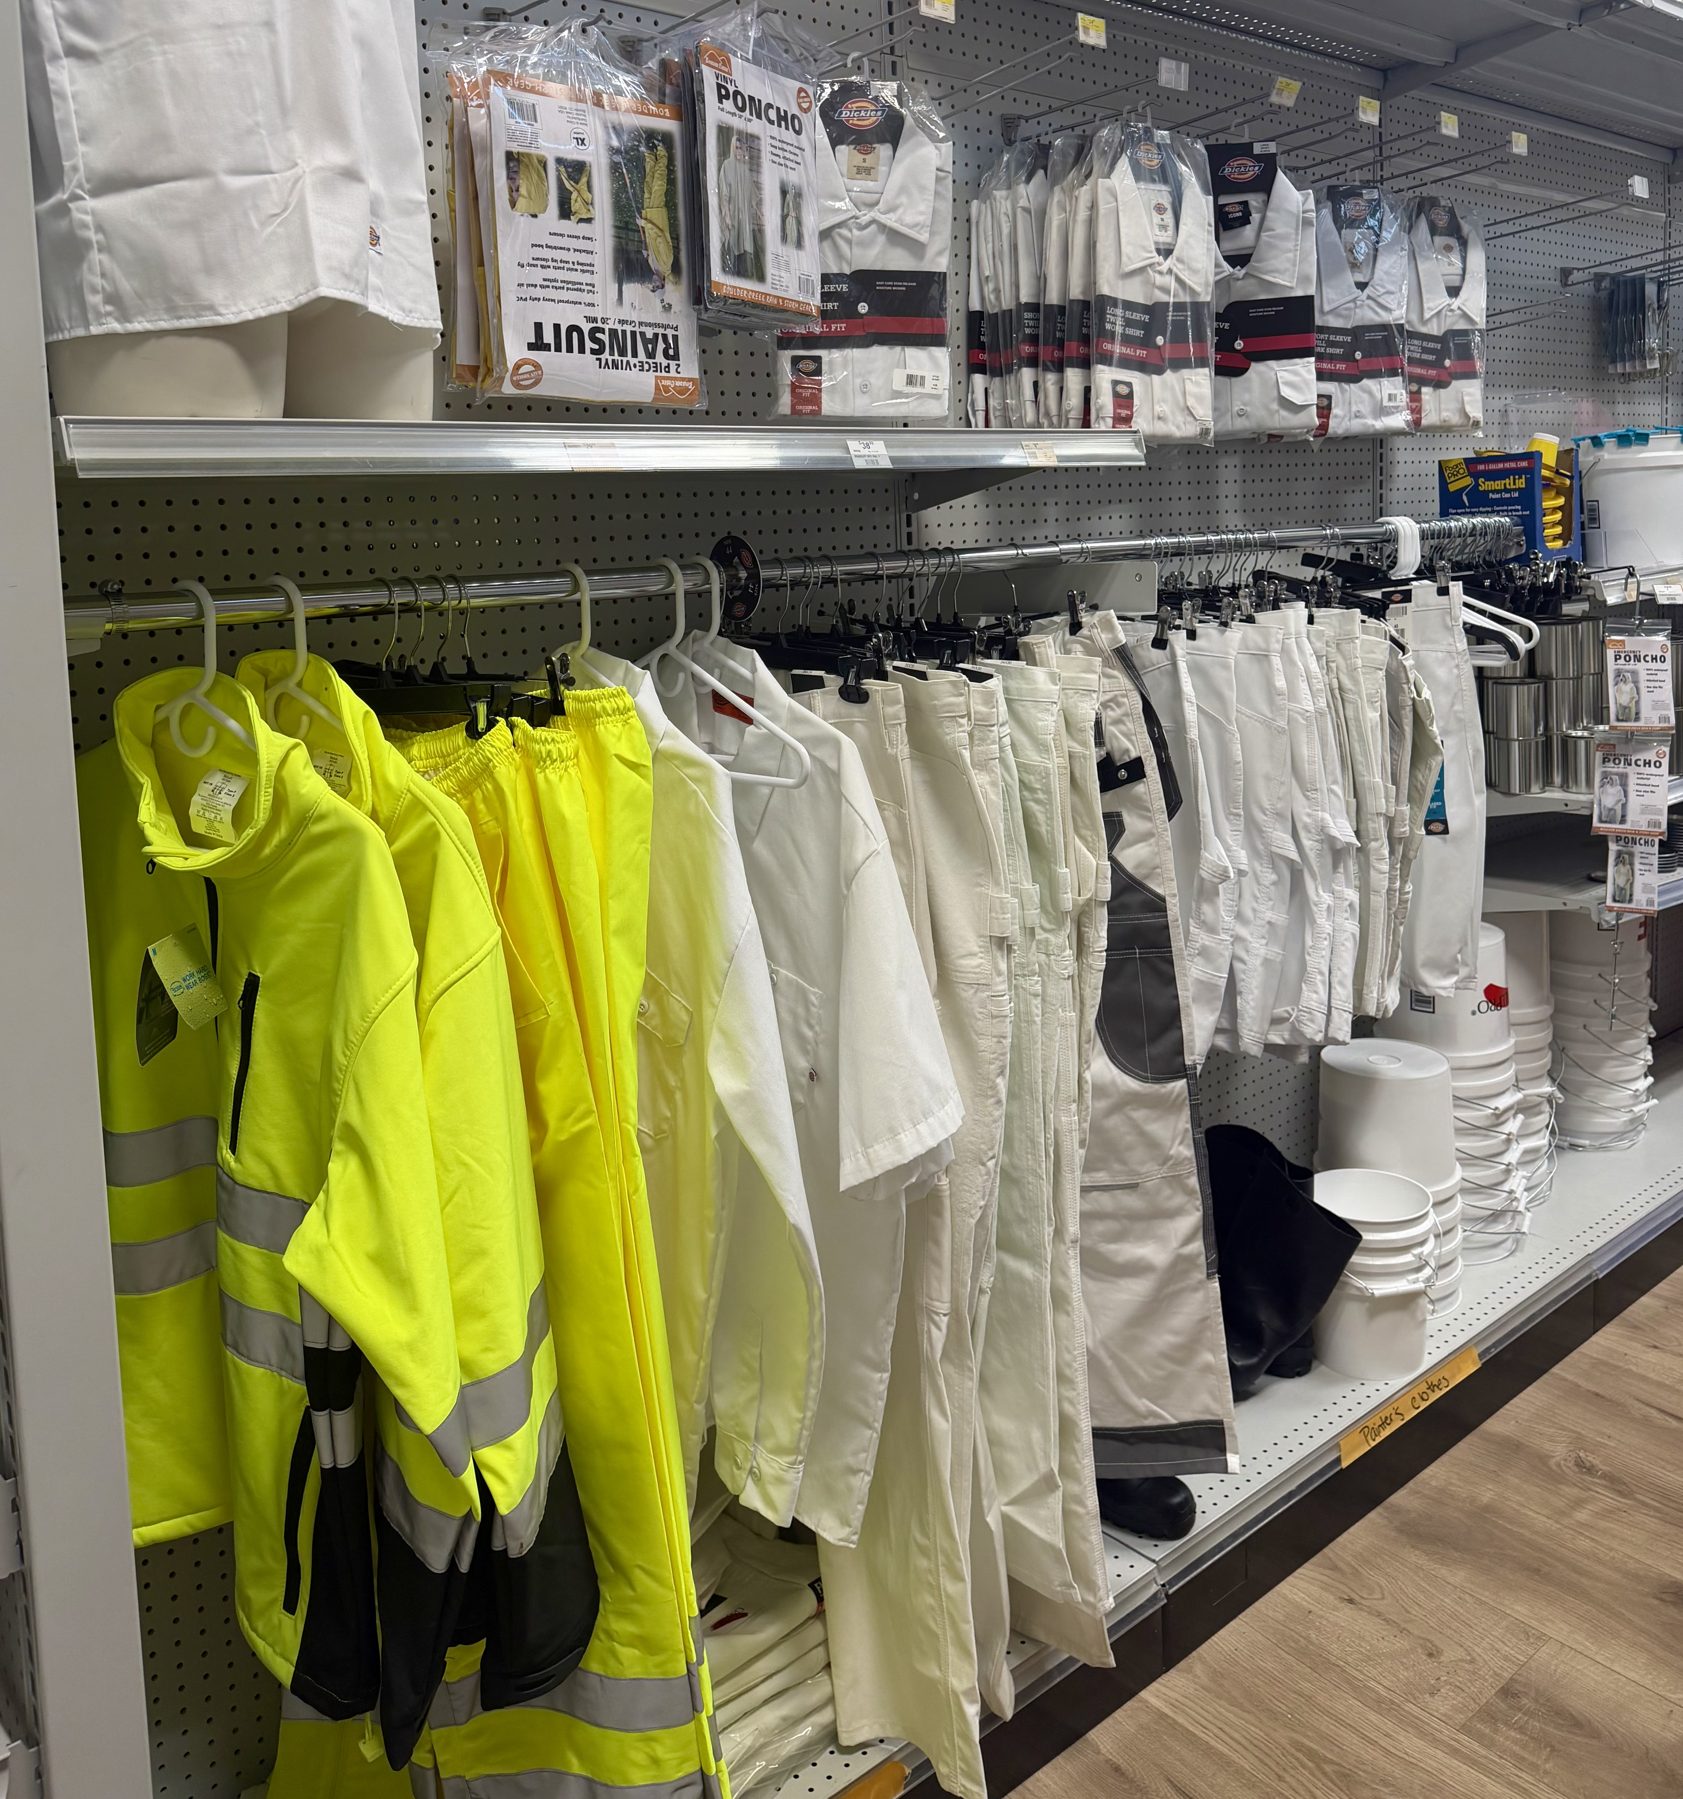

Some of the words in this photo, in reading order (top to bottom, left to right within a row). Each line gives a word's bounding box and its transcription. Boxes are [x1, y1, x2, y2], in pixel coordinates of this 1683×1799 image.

[714, 71, 738, 88] VINYL
[716, 81, 803, 136] PONCHO
[840, 109, 882, 118] Dickies
[573, 137, 587, 147] XL
[1224, 166, 1260, 174] Dickies
[1106, 306, 1124, 317] LONG
[1125, 310, 1150, 322] SLEEVE
[584, 316, 598, 324] MIL
[618, 318, 636, 328] Grade
[638, 321, 679, 332] Professional
[831, 324, 846, 332] FIT
[1125, 328, 1144, 338] SHIRT
[1330, 334, 1352, 342] SLEEVE
[527, 322, 680, 362] RAINSUIT
[1136, 350, 1148, 358] FIT
[675, 363, 681, 374] 2
[1316, 362, 1334, 370] GINAL
[1444, 462, 1464, 474] Foam
[1446, 468, 1466, 480] PRO
[1478, 474, 1526, 491] SmartLid
[1614, 654, 1667, 664] PONCHO
[1602, 757, 1662, 768] PONCHO
[1615, 836, 1656, 848] PONCHO
[1359, 1406, 1405, 1447] Painter's
